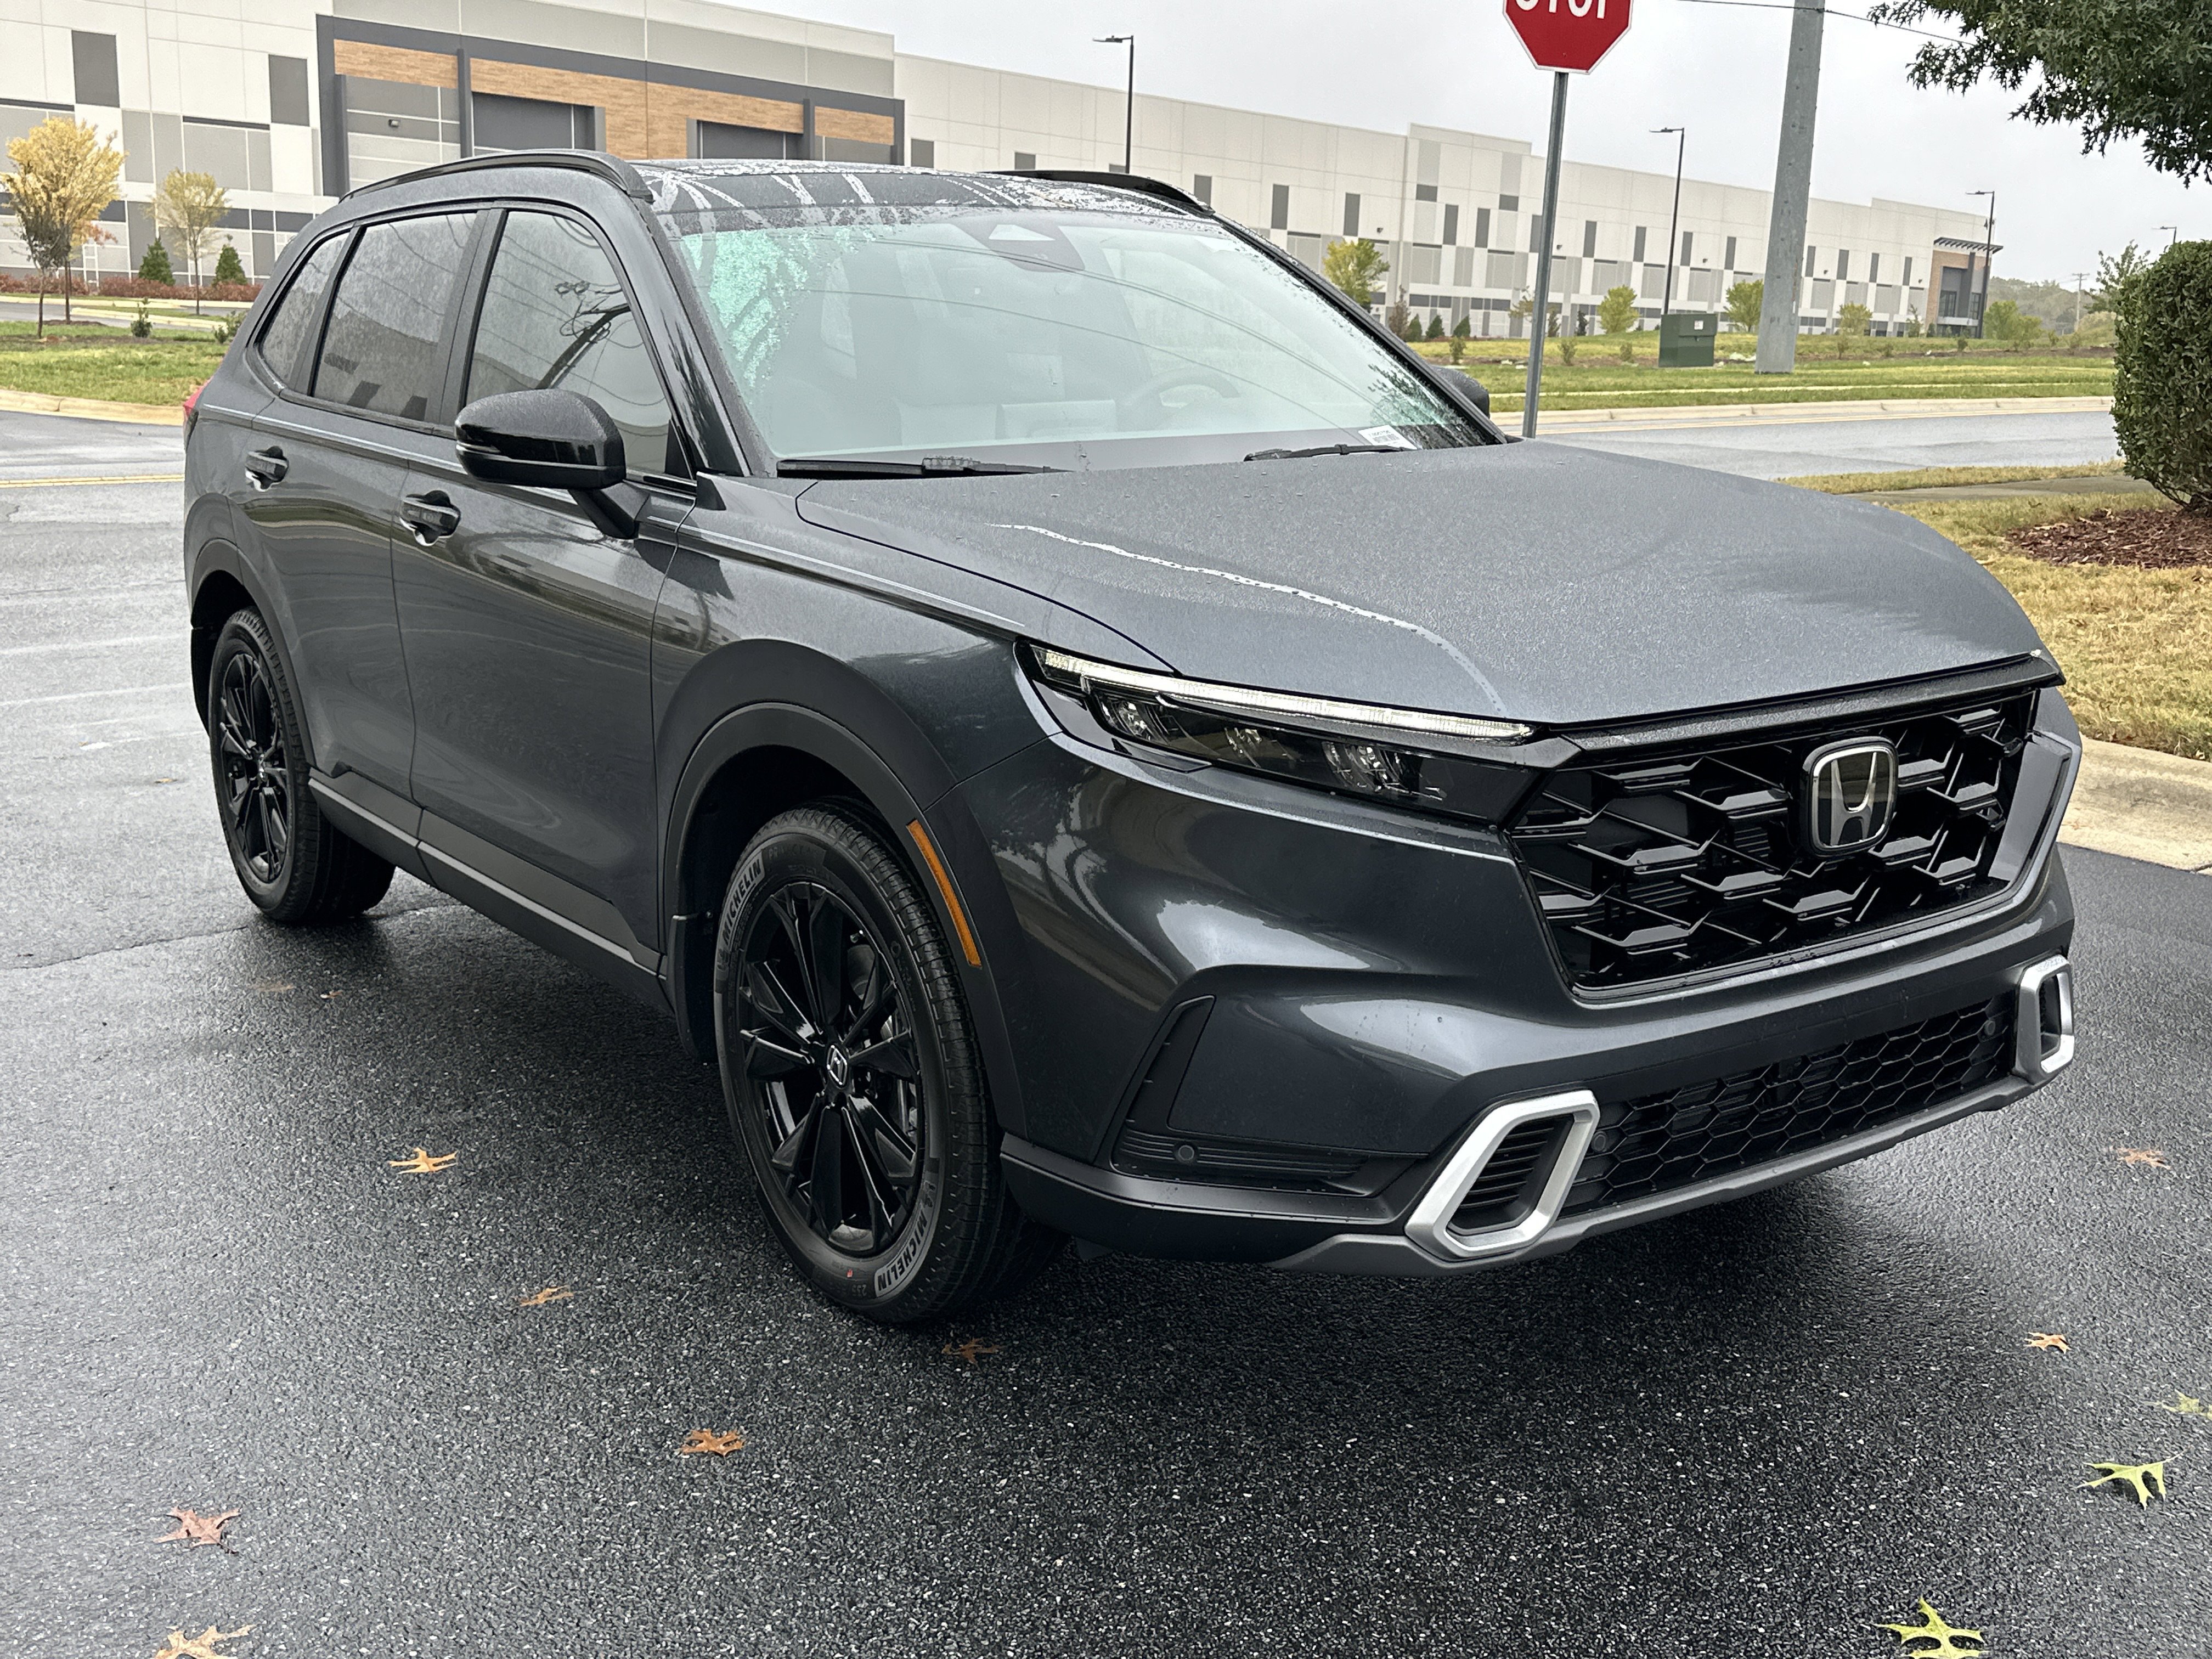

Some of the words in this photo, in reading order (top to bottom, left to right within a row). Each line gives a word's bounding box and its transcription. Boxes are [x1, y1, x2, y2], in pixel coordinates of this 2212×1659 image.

[1831, 752, 1877, 845] H
[723, 859, 761, 945] MICHELIN
[878, 1211, 927, 1291] MICHELIN
